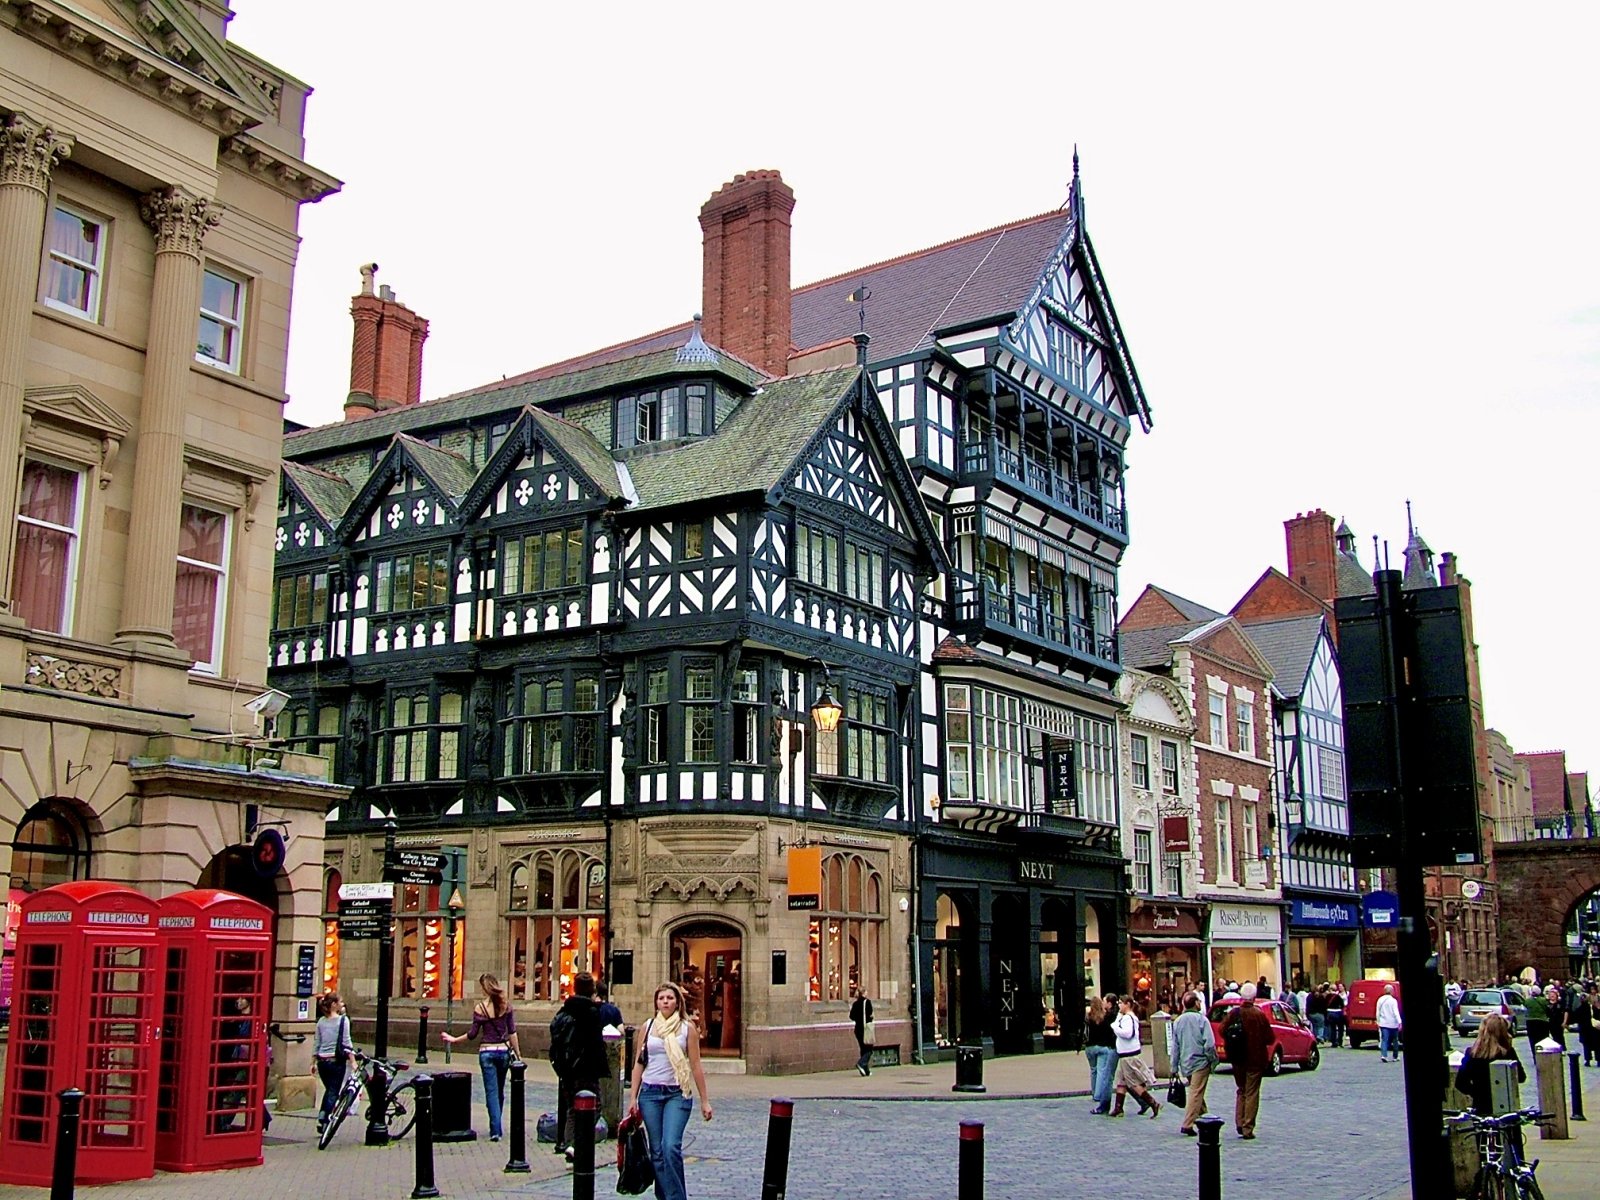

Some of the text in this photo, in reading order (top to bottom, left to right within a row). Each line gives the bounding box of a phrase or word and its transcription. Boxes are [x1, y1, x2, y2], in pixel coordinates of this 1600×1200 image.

[1058, 753, 1069, 797] NEXT
[400, 852, 439, 862] Railway Station
[1020, 861, 1054, 880] NEXT
[29, 912, 71, 922] TELEPHONE
[91, 913, 147, 923] TELEPHONE
[213, 918, 261, 928] TELEPHONE
[1220, 909, 1242, 926] Russell
[1000, 959, 1013, 1031] NEXT
